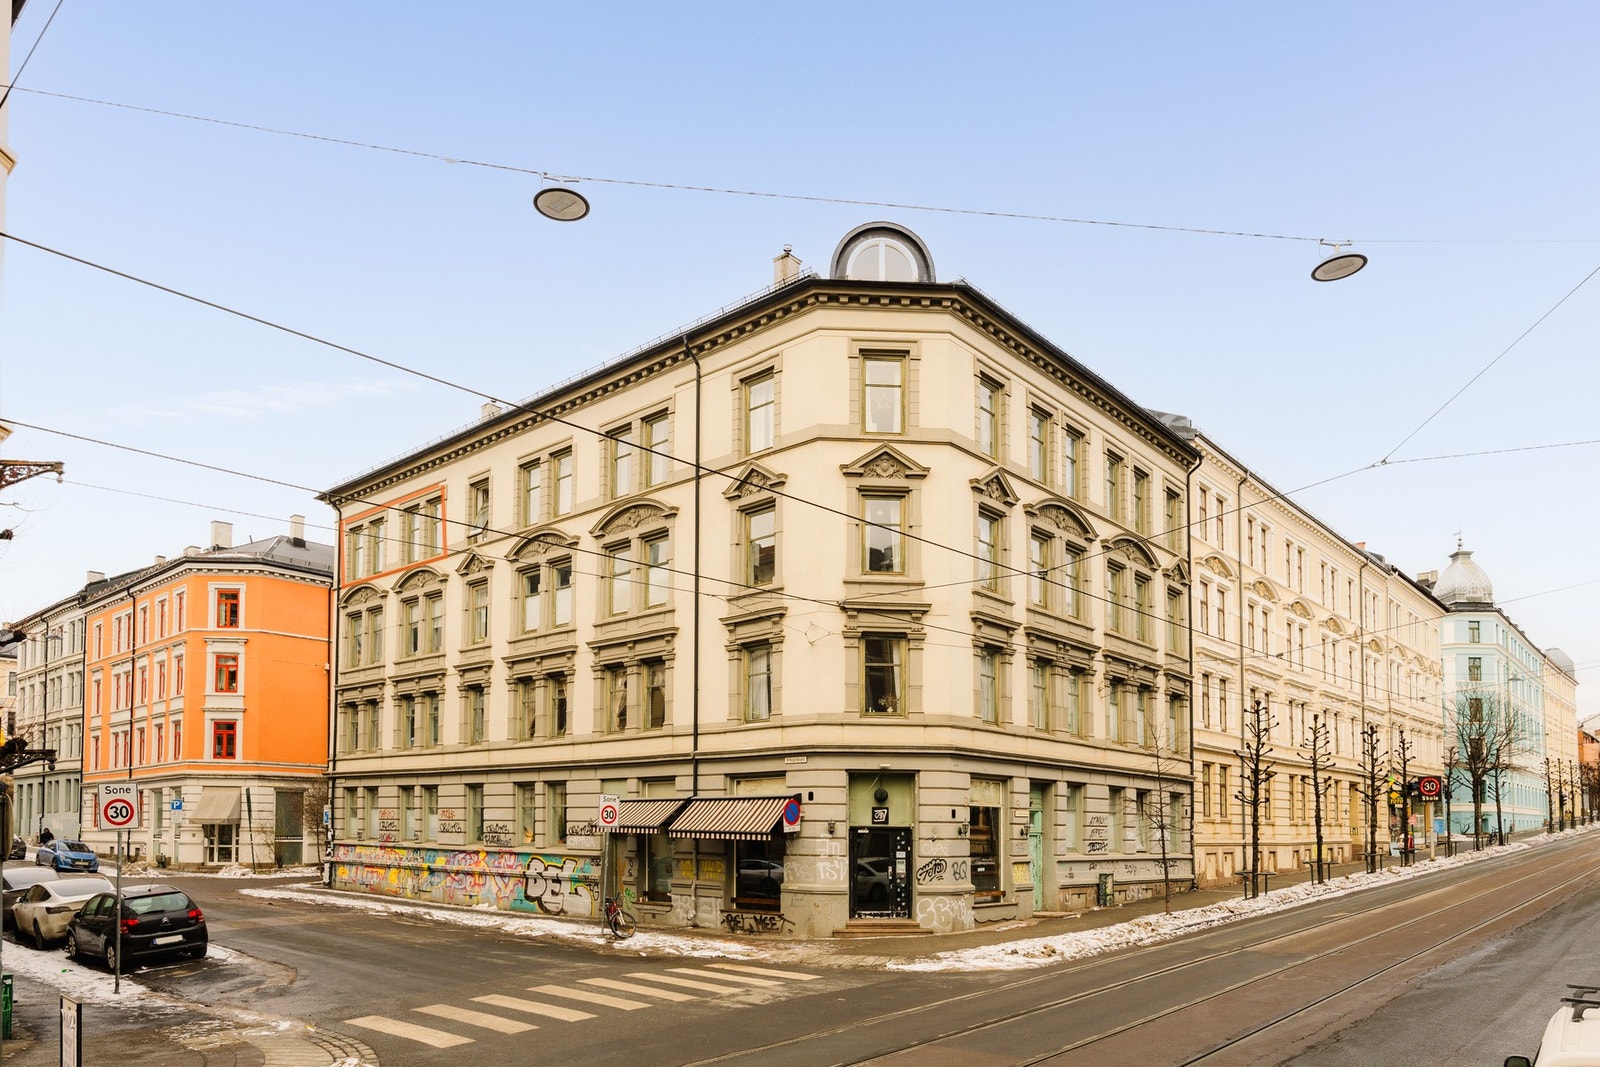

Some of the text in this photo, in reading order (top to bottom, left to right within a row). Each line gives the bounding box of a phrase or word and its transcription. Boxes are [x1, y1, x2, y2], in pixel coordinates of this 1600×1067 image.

[105, 785, 131, 795] Sone
[1424, 783, 1436, 791] 30
[603, 795, 617, 803] Sone
[173, 800, 180, 809] P
[109, 805, 129, 819] 30
[604, 810, 614, 820] 30
